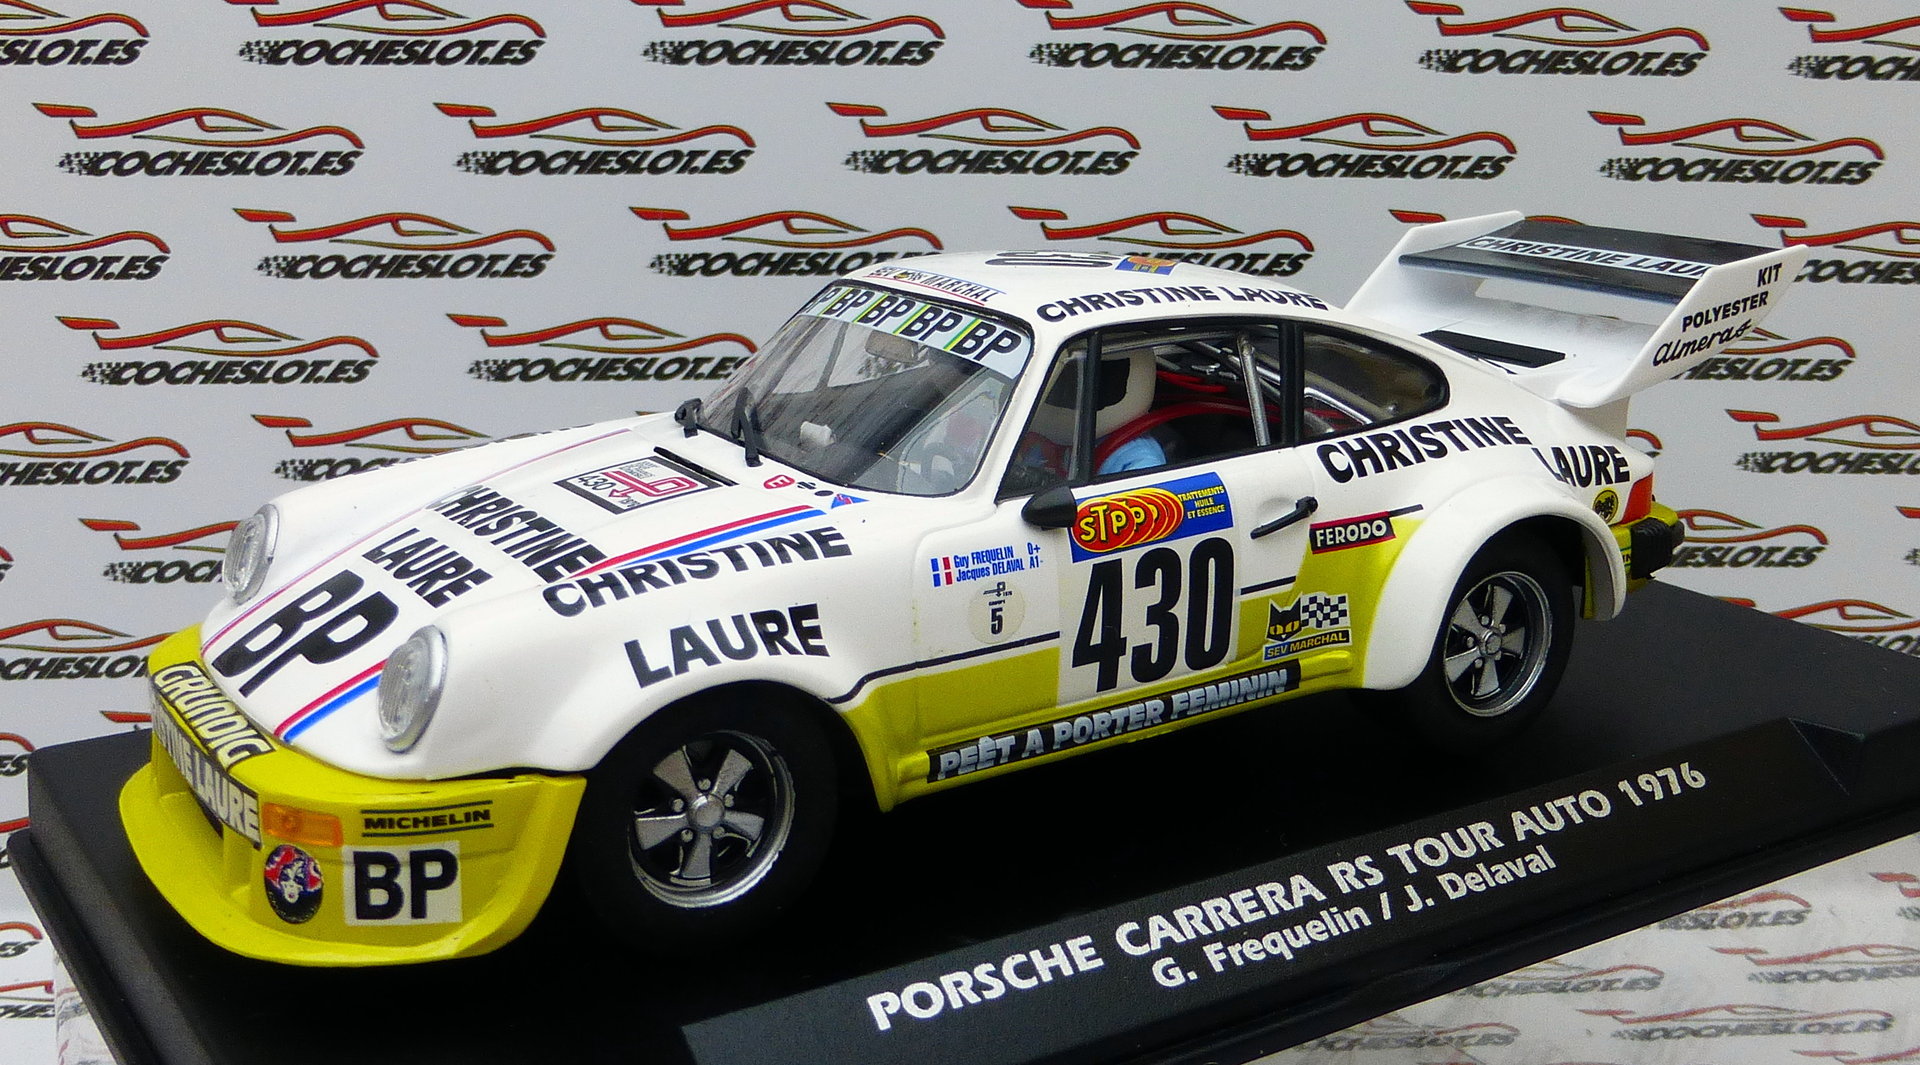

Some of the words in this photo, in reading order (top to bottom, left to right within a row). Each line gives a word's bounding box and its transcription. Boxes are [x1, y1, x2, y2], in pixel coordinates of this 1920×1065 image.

[272, 39, 546, 66] COCHESLOT.ES
[677, 39, 944, 66] COCHESLOT.ES
[1062, 42, 1327, 70] COCHESLOT.ES
[1450, 49, 1709, 78] COCHESLOT.ES
[94, 150, 364, 177] COCHESLOT.ES
[492, 149, 755, 176] COCHESLOT.ES
[876, 149, 1140, 176] COCHESLOT.ES
[1259, 153, 1515, 181] COCHESLOT.ES
[1627, 157, 1885, 186] COCHESLOT.ES
[1474, 237, 1626, 266] CHRISTINE
[286, 253, 556, 280] COCHESLOT.ES
[1756, 263, 1783, 288] KIT
[1036, 285, 1220, 323] CHRISTINE
[1218, 285, 1329, 312] LAURE
[1681, 290, 1770, 333] POLYESTER
[822, 288, 876, 318] BP
[858, 294, 917, 327] BP
[900, 303, 964, 341] BP
[950, 319, 1022, 361] BP
[112, 360, 378, 385] COCHESLOT.ES
[1315, 415, 1533, 484] CHRISTINE
[1530, 444, 1632, 488] LAURE
[577, 475, 617, 491] 430
[1187, 510, 1196, 520] ET
[1196, 504, 1226, 517] ESSENCE
[425, 483, 608, 584] CHRISTINE
[1315, 519, 1388, 548] FERODO
[361, 527, 494, 608] LAURE
[953, 554, 970, 569] Guy
[970, 545, 1014, 566] FREQUELIN
[956, 566, 991, 582] Jacques
[991, 557, 1025, 577] DELAVAL
[542, 526, 853, 618] CHRISTINE
[990, 606, 1004, 635] 5
[1071, 536, 1236, 693] 430
[211, 569, 399, 698] BP
[623, 602, 830, 690] LAURE
[1266, 645, 1289, 659] SEV
[1289, 632, 1347, 654] MARCHAL
[153, 664, 273, 770] GRUNDIG
[1021, 729, 1045, 759] A
[1051, 699, 1165, 750] PORTER
[1170, 668, 1289, 720] FEMININ
[363, 808, 492, 831] MICHELIN
[352, 848, 459, 920] BP
[866, 934, 1105, 1032] PORSCHE
[1115, 873, 1328, 957] CARRERA
[1329, 854, 1386, 895] RS
[1387, 818, 1505, 878] TOUR
[1511, 788, 1614, 844] AUTO
[1616, 762, 1709, 810] 1976
[1151, 953, 1198, 989] G.
[1201, 905, 1373, 975] Frequelin
[1404, 880, 1437, 914] J.
[1445, 844, 1557, 902] Delaval
